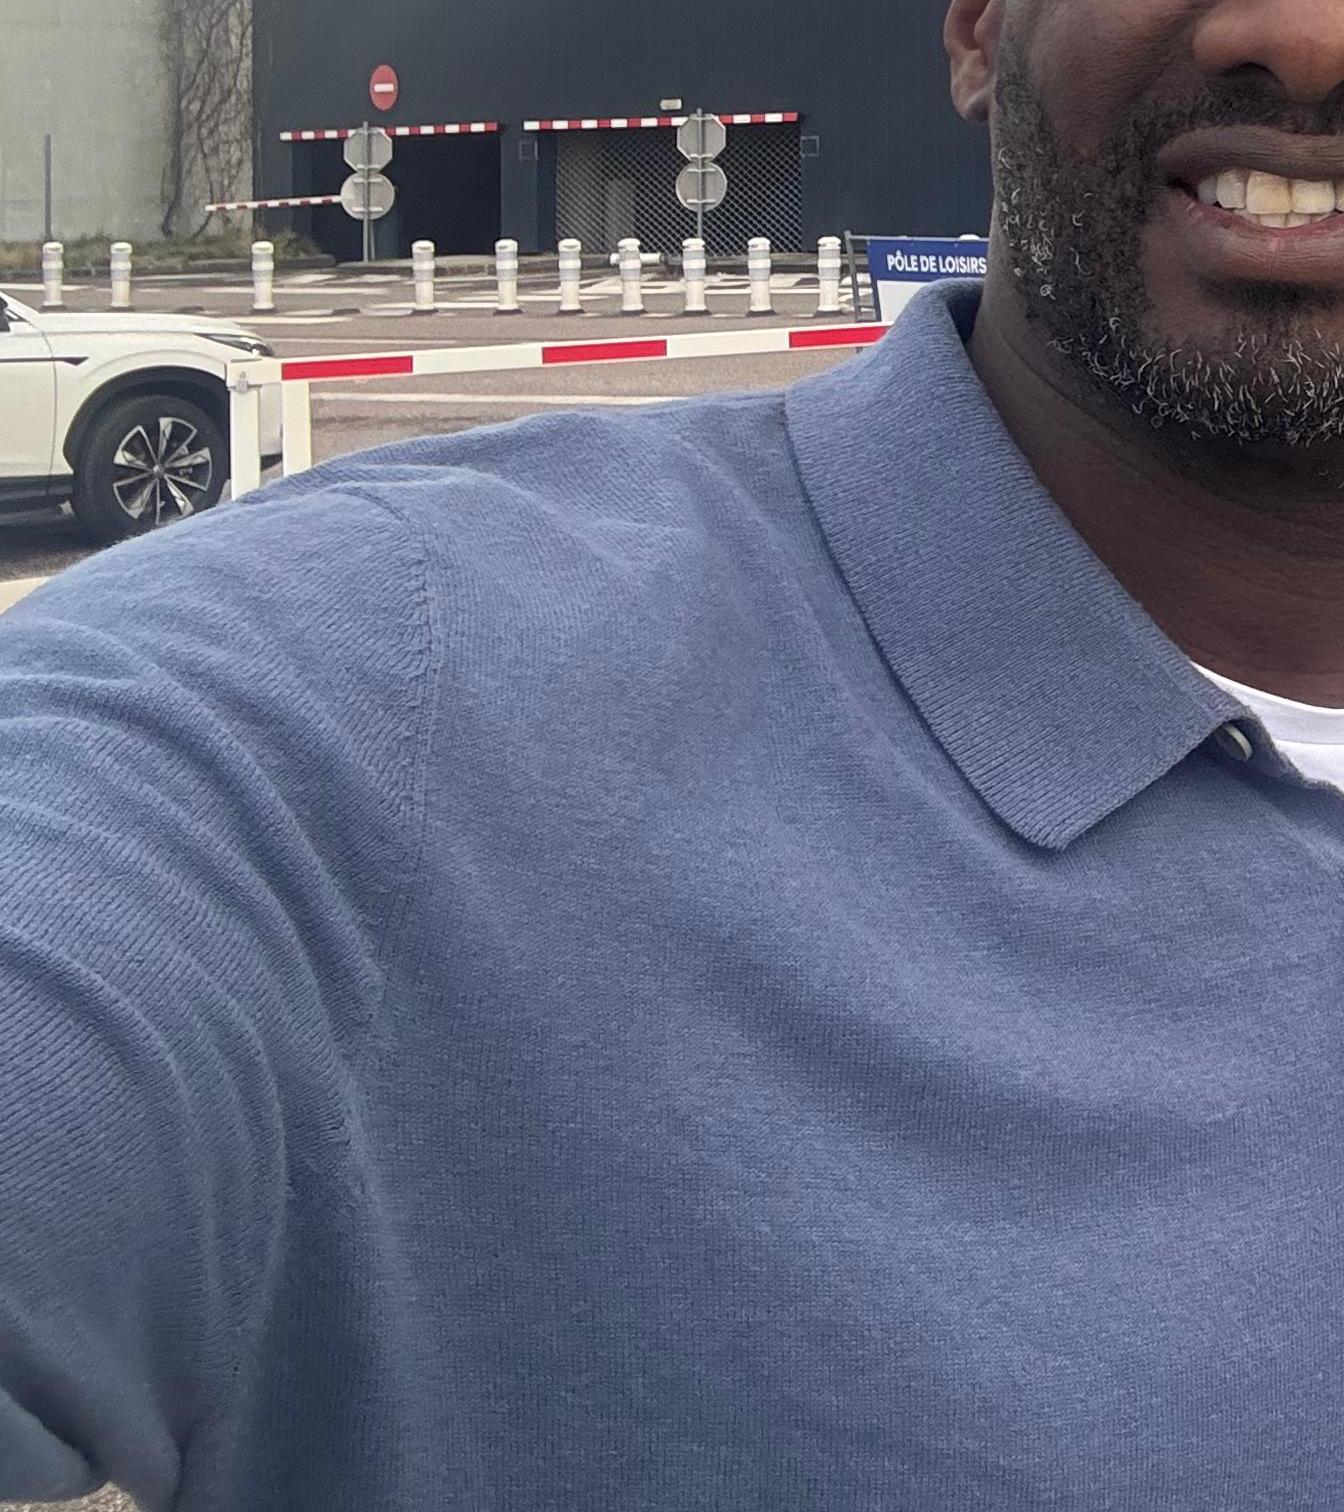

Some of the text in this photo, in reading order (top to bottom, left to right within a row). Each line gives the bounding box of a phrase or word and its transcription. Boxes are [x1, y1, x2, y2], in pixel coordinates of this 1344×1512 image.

[887, 249, 987, 274] PÔLE DE LOISIRS
